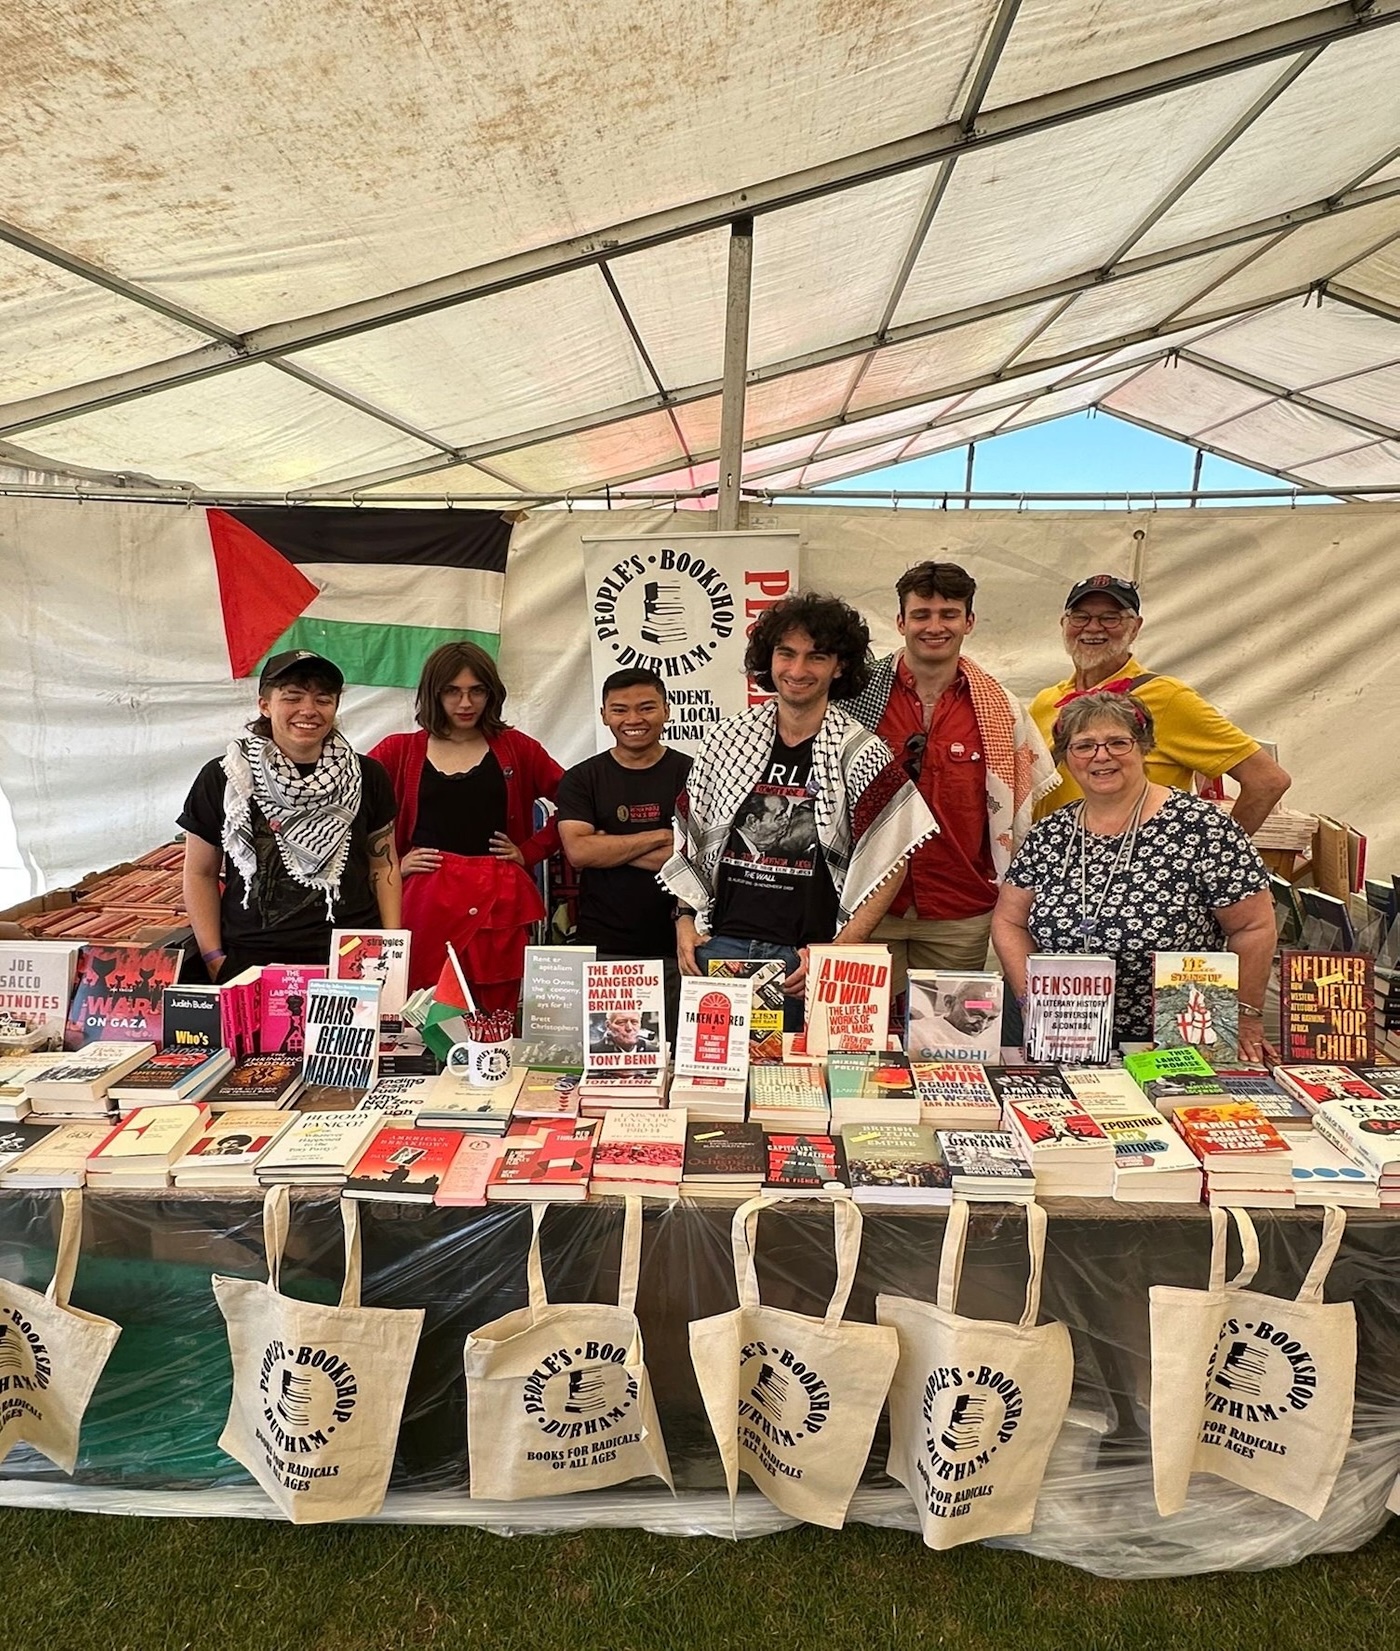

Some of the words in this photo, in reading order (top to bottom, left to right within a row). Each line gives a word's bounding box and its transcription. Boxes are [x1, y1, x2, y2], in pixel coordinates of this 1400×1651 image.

[594, 554, 645, 641] PEOPLE'S
[660, 550, 734, 638] BOOKSHOP
[616, 644, 712, 680] DURHAM
[668, 690, 713, 706] NDENT,
[756, 873, 776, 881] WALL
[367, 938, 404, 947] struggles
[392, 950, 402, 958] for
[9, 960, 33, 972] JOE
[588, 966, 608, 976] THE
[612, 964, 644, 975] MOST
[820, 959, 831, 980] A
[834, 960, 888, 987] WORLD
[1290, 956, 1366, 985] NEITHER
[0, 976, 40, 988] SACCO
[588, 976, 658, 987] DANGEROUS
[1032, 976, 1112, 996] CENSORED
[588, 989, 616, 999] MAN
[620, 989, 633, 998] IN
[818, 981, 837, 1003] TO
[839, 984, 871, 1004] WIN
[1318, 984, 1366, 1010] DEVIL
[0, 995, 59, 1009] OTNOTES
[87, 996, 149, 1016] WAR
[170, 999, 192, 1008] Judith
[193, 1001, 213, 1009] Butler
[589, 1000, 642, 1011] BRITAIN?
[829, 1007, 844, 1015] THE
[845, 1006, 860, 1015] LIFE
[862, 1004, 878, 1014] AND
[307, 995, 358, 1026] TRANS
[87, 1017, 106, 1027] ON
[110, 1018, 147, 1028] GAZA
[686, 1012, 712, 1024] TAKEN
[714, 1014, 725, 1025] AS
[728, 1016, 744, 1026] RED
[829, 1016, 859, 1026] WORKS
[860, 1015, 870, 1024] OF
[1331, 1010, 1366, 1036] NOR
[830, 1025, 851, 1034] KARL
[852, 1024, 874, 1033] MARX
[175, 1030, 209, 1045] Who's
[315, 1026, 376, 1057] GENDER
[1291, 1034, 1306, 1045] TOM
[920, 1048, 987, 1061] GANDHI
[1291, 1047, 1315, 1058] YOUNG
[1316, 1034, 1368, 1061] CHILD
[590, 1055, 621, 1066] TONY
[624, 1054, 656, 1065] BENN
[1156, 1061, 1201, 1069] PROMISE
[303, 1055, 374, 1089] MARXISM
[933, 1071, 985, 1083] WIN
[755, 1086, 822, 1094] SOCIALISM
[919, 1088, 991, 1096] ORGANISING
[1032, 1109, 1080, 1118] RIGHT
[1101, 1116, 1162, 1131] EPORTING
[1191, 1121, 1238, 1130] TARIQ
[1239, 1118, 1265, 1128] ALI
[950, 1139, 1016, 1148] UKRAINE
[1203, 1134, 1272, 1143] FIGHTING
[1218, 1141, 1267, 1149] YEARS
[11, 1309, 52, 1390] BOOKSHOP
[1254, 1321, 1316, 1410] BOOKSHOP
[296, 1346, 358, 1423] BOOKSHOP
[523, 1348, 572, 1414] PEOPLE'S
[779, 1349, 830, 1434] BOOKSHOP
[923, 1367, 963, 1423] PEOPLE'S
[975, 1365, 1023, 1444] BOOKSHOP
[542, 1406, 627, 1438] DURHAM
[264, 1407, 329, 1453] DURHAM
[1203, 1420, 1227, 1434] FOR
[1229, 1427, 1287, 1455] RADICALS
[527, 1451, 564, 1460] BOOKS
[568, 1445, 588, 1458] FOR
[592, 1433, 640, 1453] RADICALS
[743, 1427, 761, 1446] FOR
[762, 1441, 803, 1479] RADICALS
[1201, 1433, 1222, 1446] ALL
[1224, 1440, 1255, 1459] AGES
[553, 1461, 566, 1470] OF
[570, 1458, 588, 1468] ALL
[592, 1450, 616, 1464] AGES
[742, 1437, 758, 1455] ALL
[758, 1453, 777, 1477] AGES
[926, 1438, 990, 1481] DURHAM
[287, 1462, 339, 1478] RADICALS
[283, 1476, 310, 1491] AGES
[930, 1486, 952, 1503] FOR
[954, 1485, 994, 1503] RADICALS
[929, 1502, 947, 1518] ALL
[950, 1502, 971, 1518] AGES
